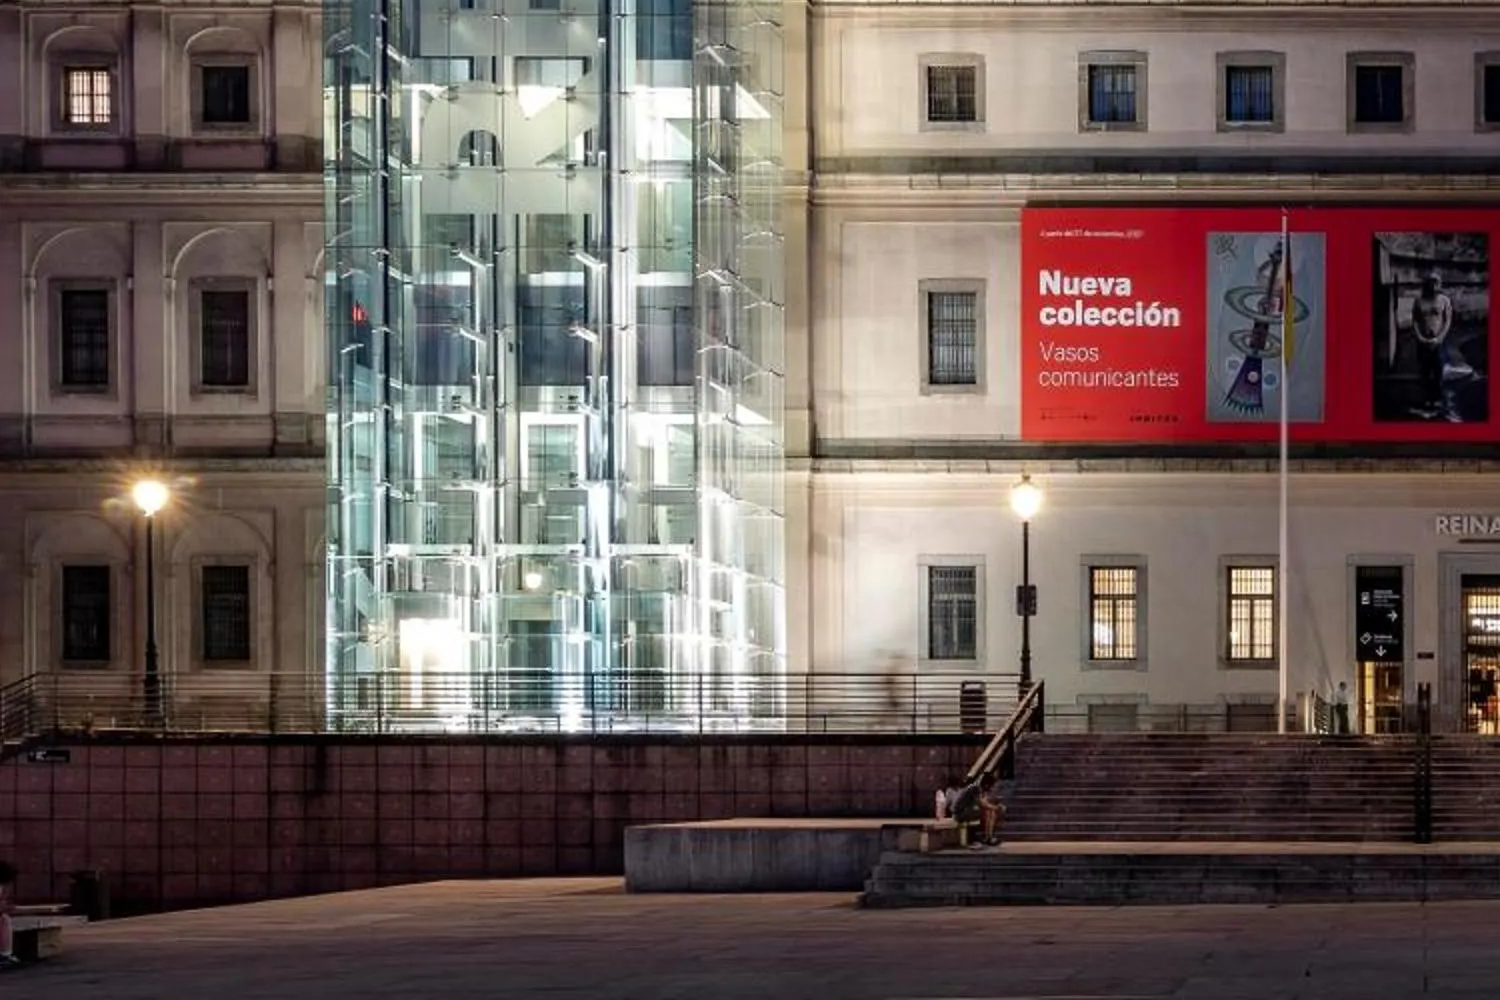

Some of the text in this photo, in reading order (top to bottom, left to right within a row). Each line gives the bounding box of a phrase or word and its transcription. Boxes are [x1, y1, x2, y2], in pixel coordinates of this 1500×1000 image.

[1039, 269, 1132, 297] Nueva
[1039, 299, 1181, 327] colección
[1039, 341, 1100, 362] Vasos
[1039, 367, 1180, 388] comunicantes
